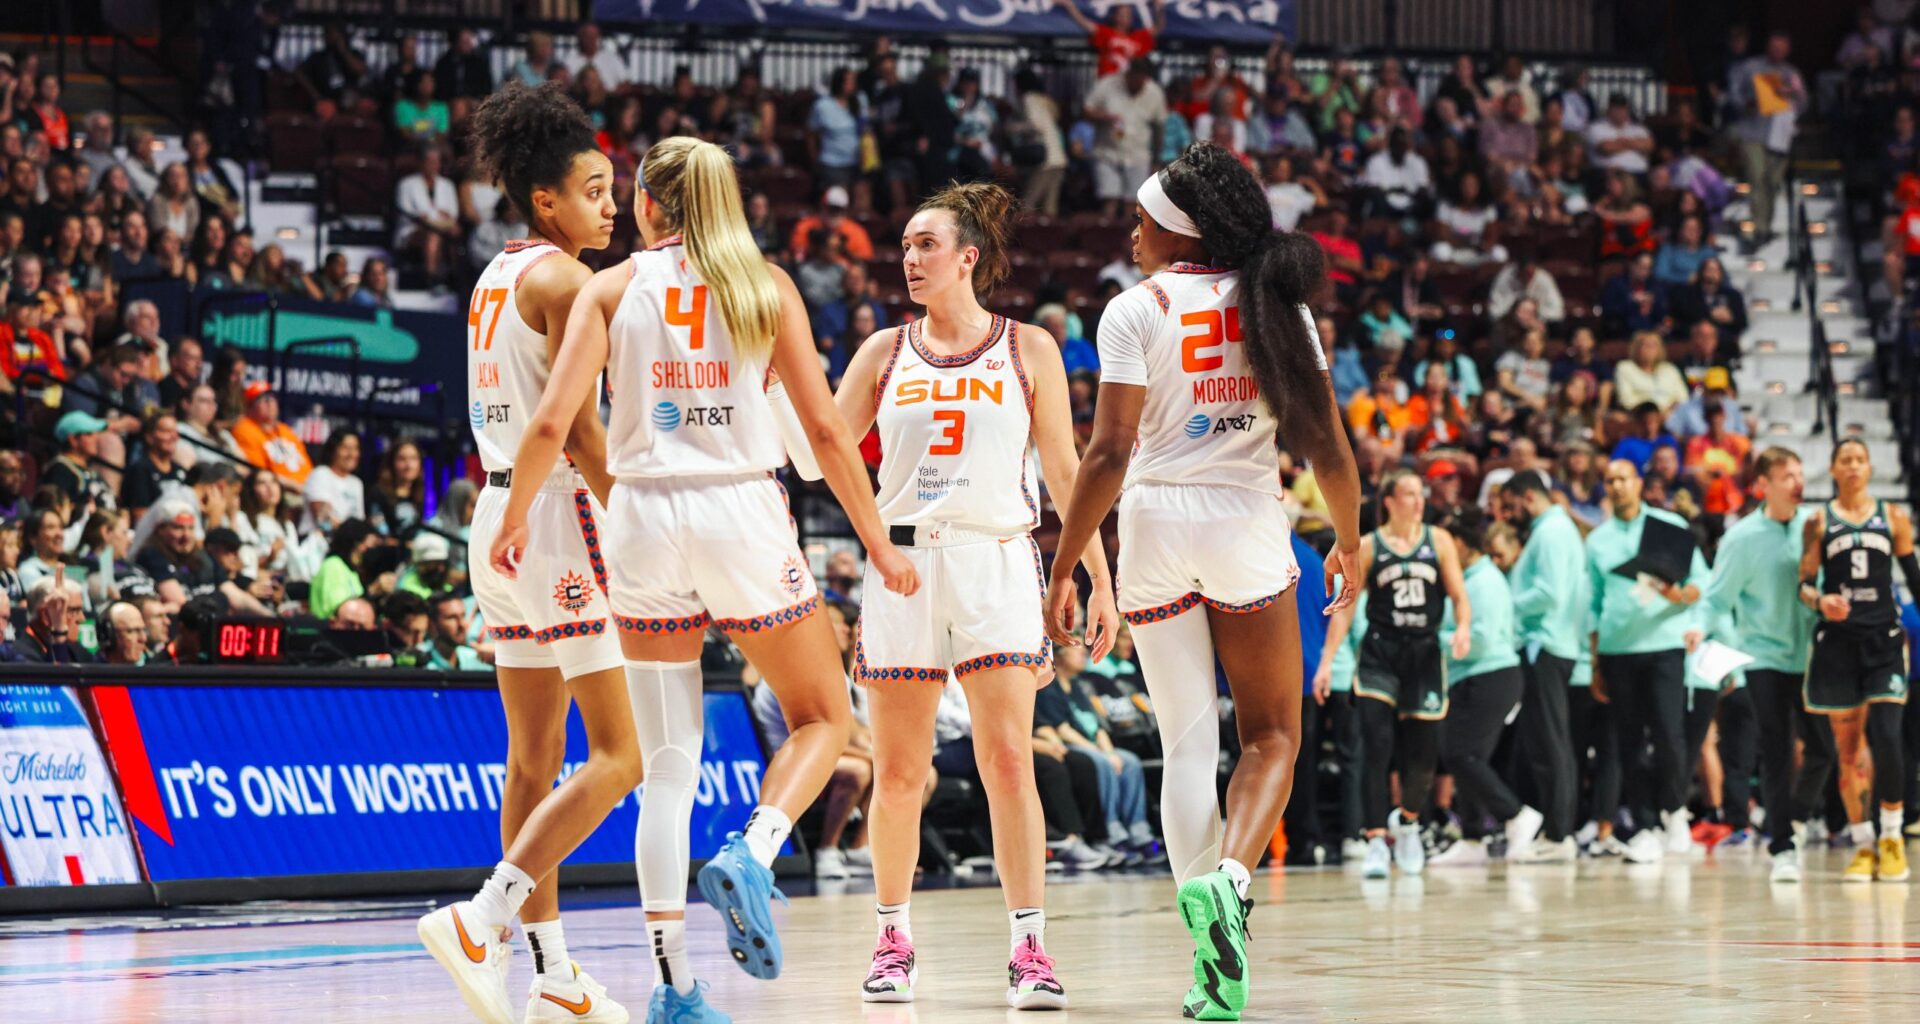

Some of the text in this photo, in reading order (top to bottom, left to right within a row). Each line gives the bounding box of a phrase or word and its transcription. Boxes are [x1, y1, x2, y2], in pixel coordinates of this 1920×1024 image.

[469, 288, 509, 351] 47
[665, 285, 707, 350] 4
[652, 361, 729, 389] SHELDON
[895, 378, 1003, 406] SUN
[1193, 376, 1260, 405] MORROW
[487, 404, 511, 423] AT&T
[685, 406, 734, 426] AT&T
[1213, 414, 1257, 434] AT&T
[929, 410, 965, 456] 3
[918, 466, 938, 476] Yale
[1850, 549, 1868, 579] 9
[566, 585, 582, 600] C
[1392, 578, 1426, 609] 20
[220, 625, 280, 657] 00:11
[0, 686, 51, 695] UPERIOR
[0, 700, 28, 713] IGHT
[3, 752, 86, 784] Michelob
[240, 765, 336, 817] ONLY
[338, 763, 479, 814] WORTH
[732, 761, 774, 805] IT
[0, 793, 124, 838] ULTRA
